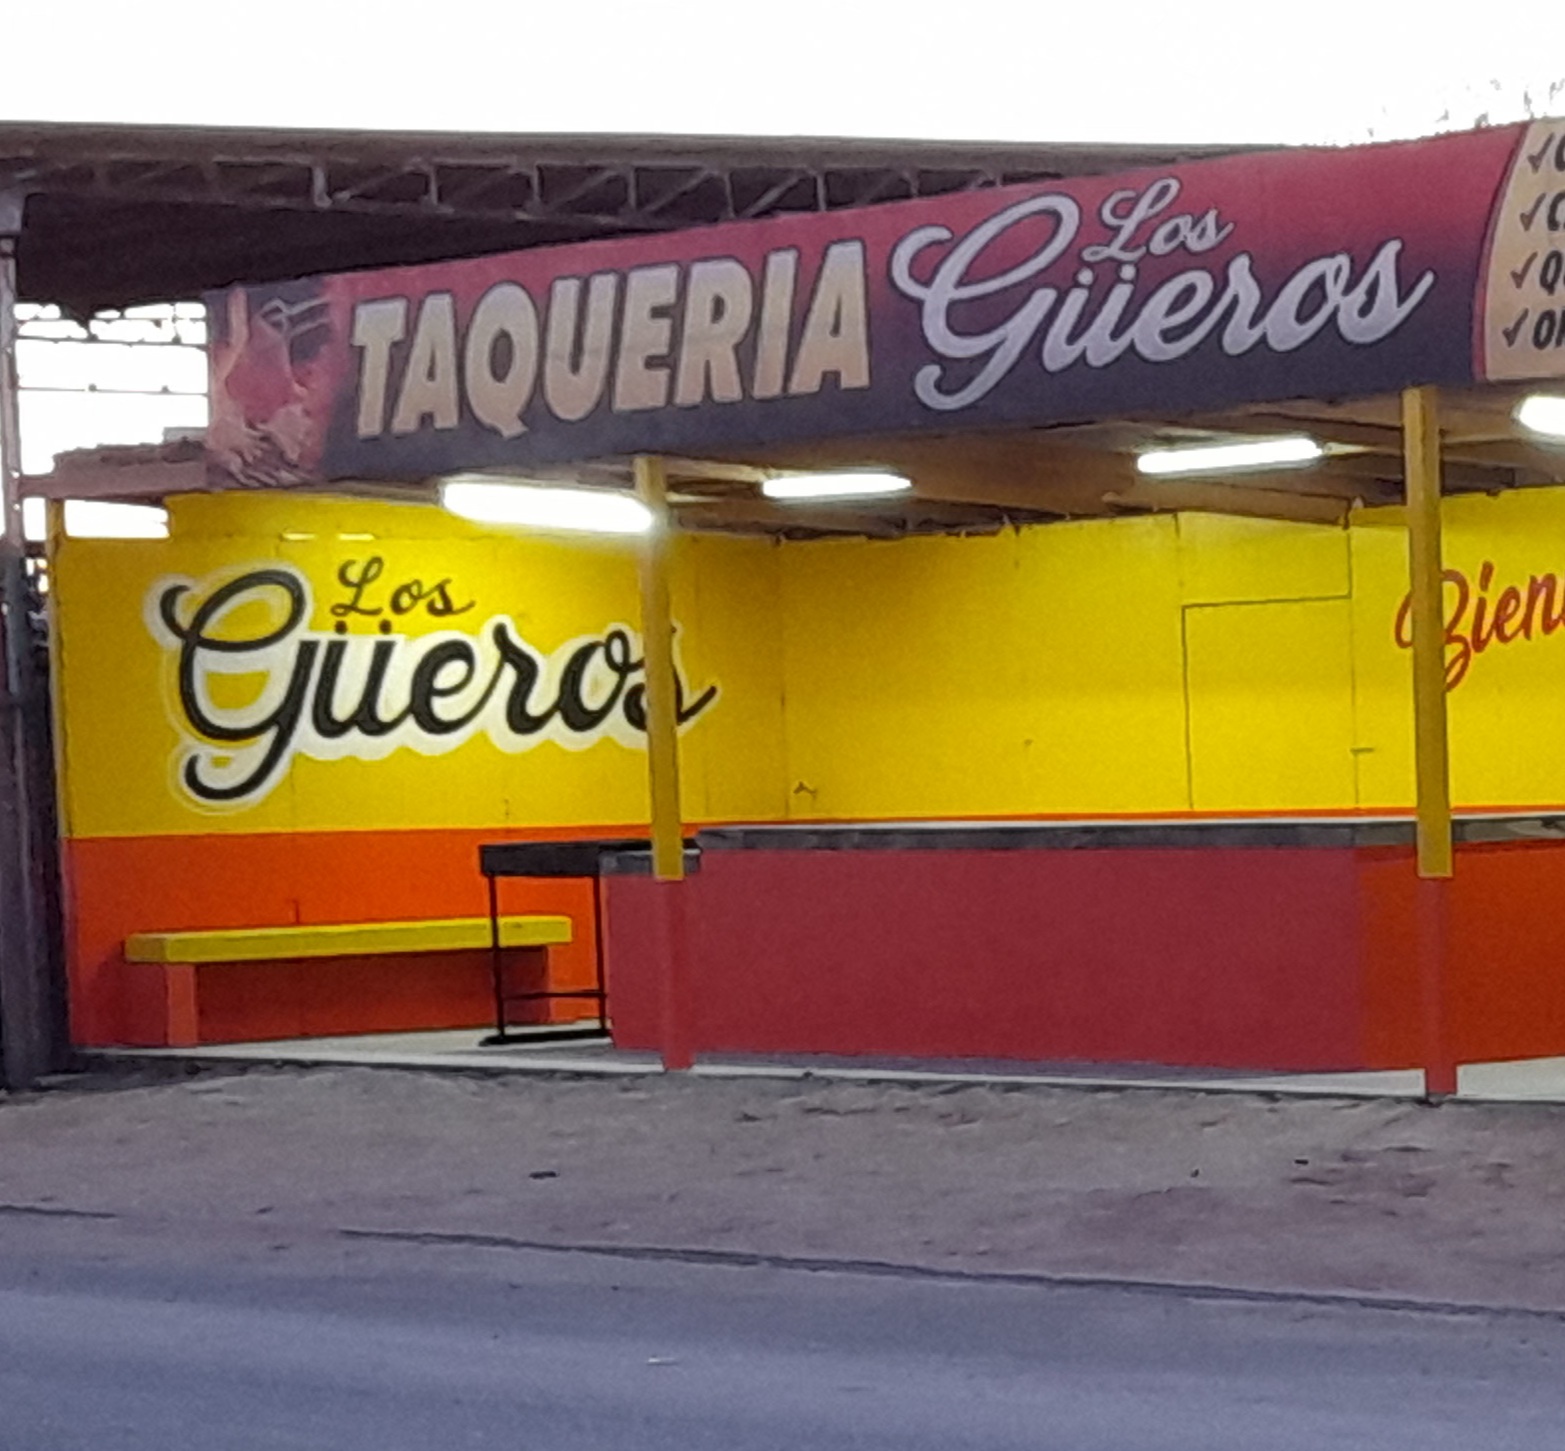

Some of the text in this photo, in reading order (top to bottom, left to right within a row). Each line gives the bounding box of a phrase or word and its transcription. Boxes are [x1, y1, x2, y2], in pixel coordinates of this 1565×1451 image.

[1083, 178, 1232, 262] Los
[352, 239, 871, 438] TAQUERIA
[891, 192, 1434, 410] Güeros
[331, 556, 475, 616] Los
